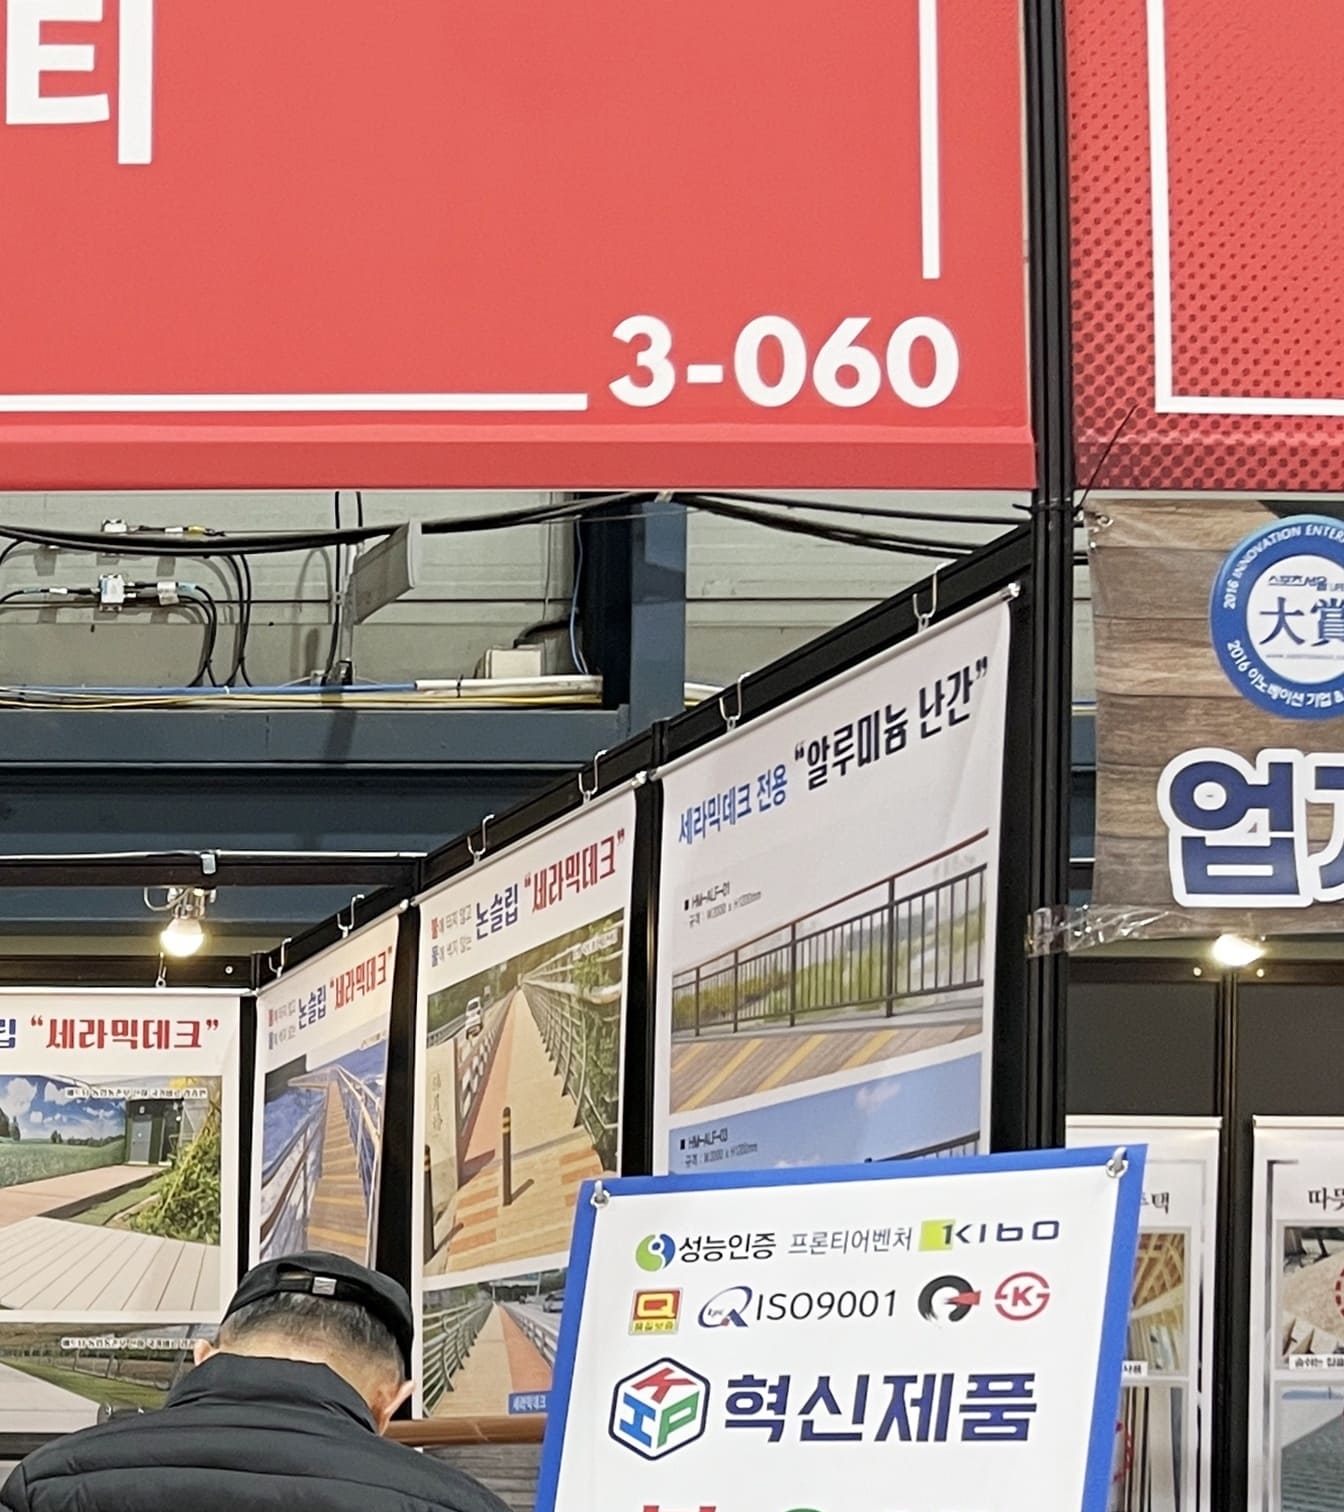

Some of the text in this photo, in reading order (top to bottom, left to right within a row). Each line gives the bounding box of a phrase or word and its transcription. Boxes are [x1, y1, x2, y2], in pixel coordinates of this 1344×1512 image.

[606, 315, 961, 411] 3-060
[1231, 525, 1302, 579] INNOVATION
[1223, 579, 1240, 610] 2016
[1227, 639, 1249, 672] 2016
[678, 783, 752, 844] 세라믹데크
[757, 764, 788, 813] 전용
[476, 883, 518, 940] 논슬립
[678, 1231, 777, 1263] 성능인증
[788, 1227, 912, 1256] 프론티어벤처
[756, 1290, 898, 1322] ISO9001
[724, 1373, 1038, 1443] 혁신제품
